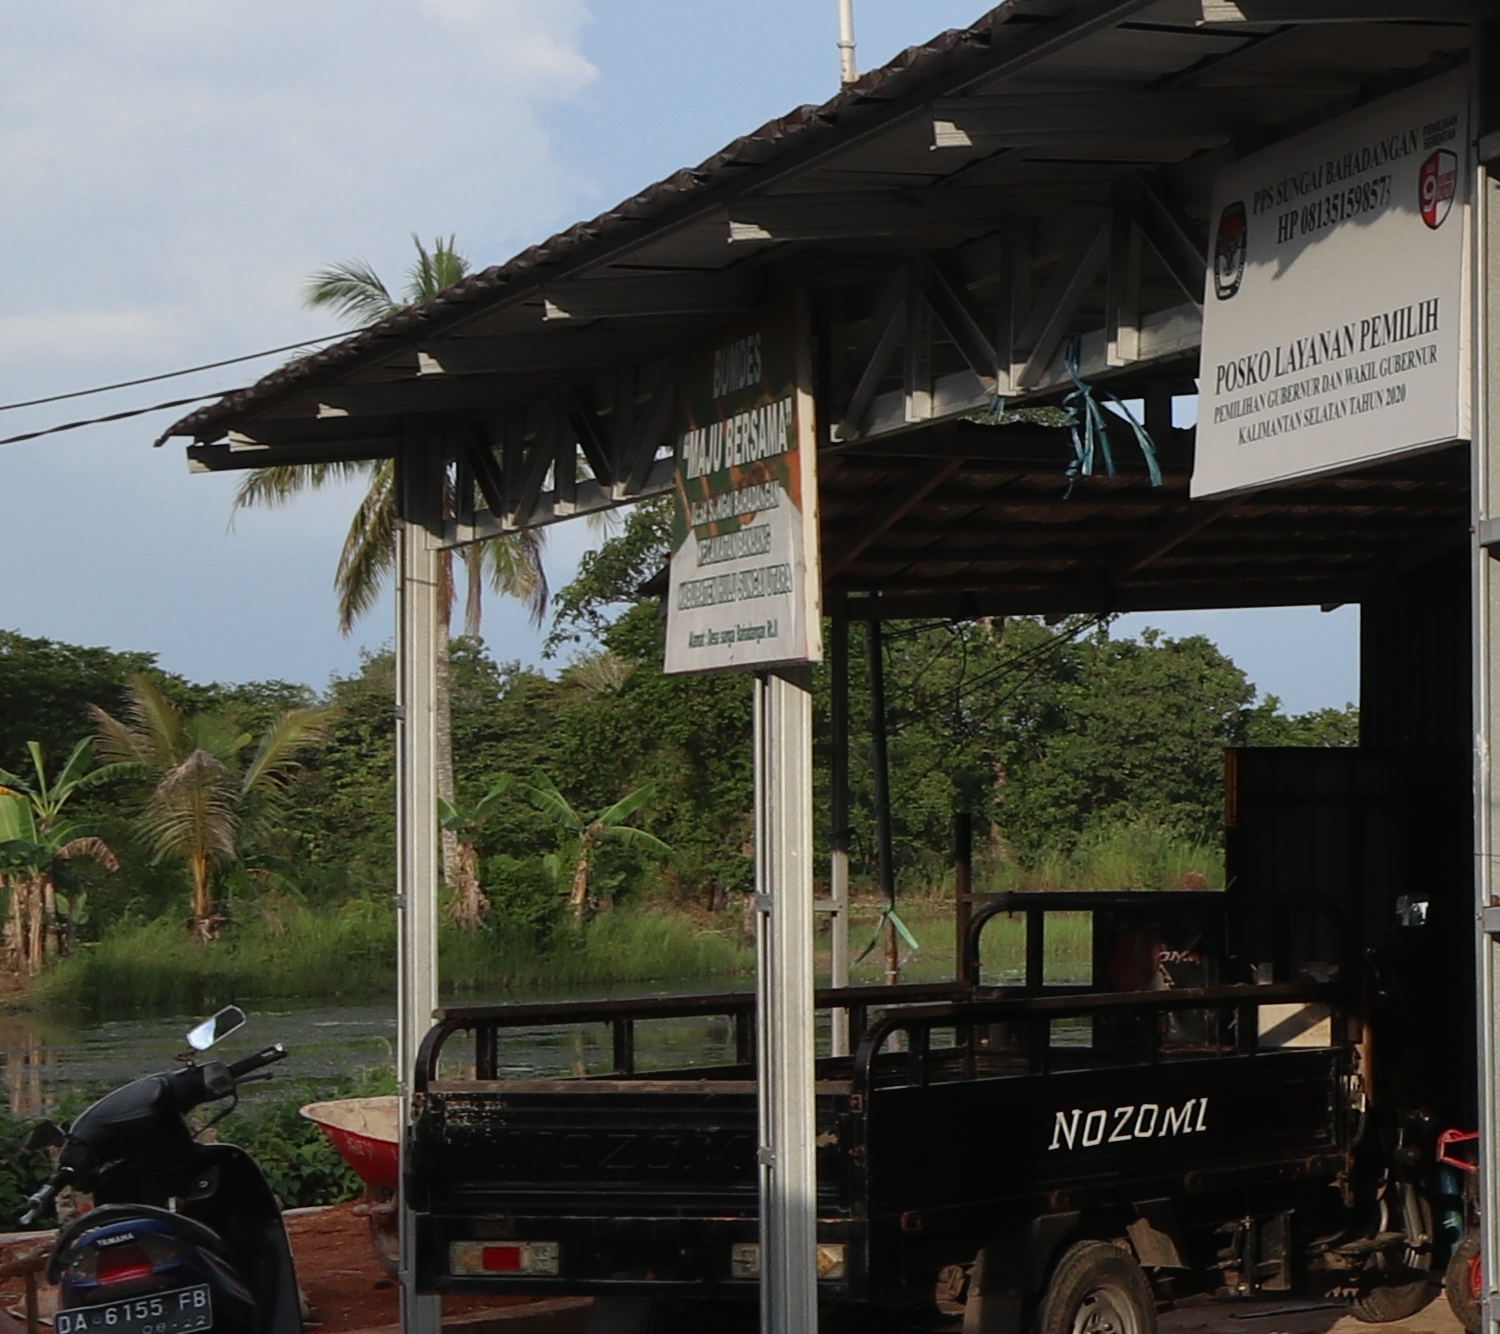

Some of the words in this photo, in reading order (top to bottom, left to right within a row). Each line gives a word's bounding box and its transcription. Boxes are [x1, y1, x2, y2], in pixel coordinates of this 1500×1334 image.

[1277, 210, 1299, 244] HP
[1216, 350, 1271, 394] POSKO
[1274, 323, 1357, 376] LAYANAN
[1359, 298, 1439, 353] PEMILIH
[1215, 393, 1266, 423] PEMILIHAN
[1268, 376, 1321, 409] GUBERNUR
[1321, 369, 1344, 394] DAN
[1380, 345, 1437, 378] GUBERNUR
[1239, 412, 1302, 445] KALIMANTAN
[1304, 399, 1347, 427] SELATAN
[1348, 389, 1384, 415] TAHUN
[1048, 1097, 1208, 1151] NOZOMI
[97, 1233, 135, 1246] YAMAHA
[58, 1313, 87, 1334] DA
[105, 1299, 163, 1325] 6155
[179, 1290, 206, 1310] FB
